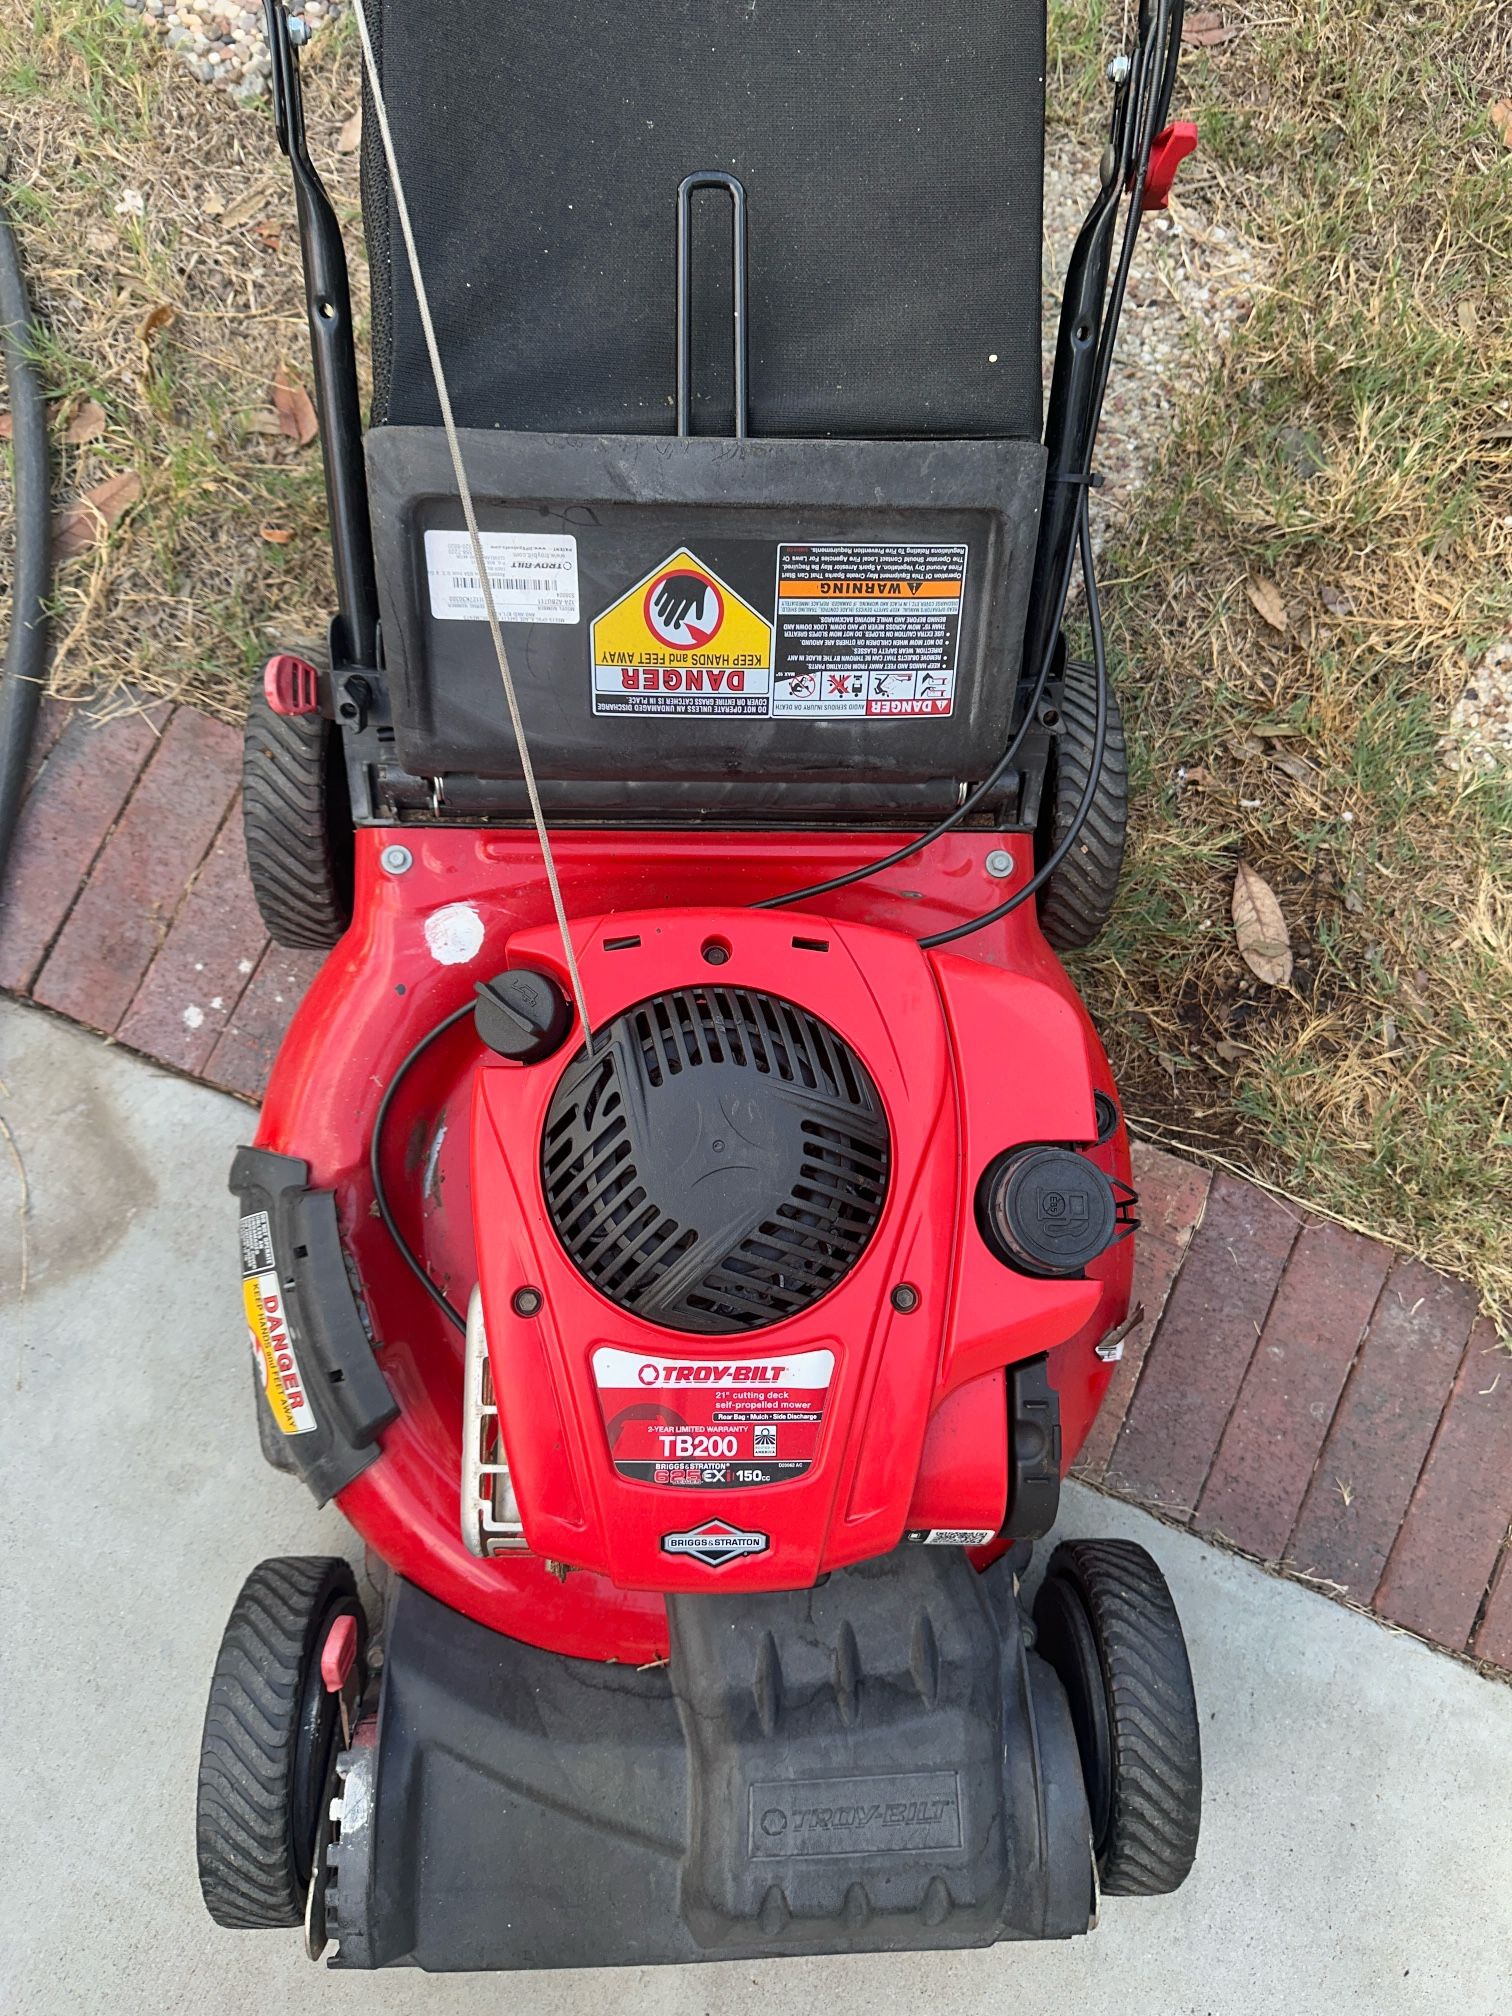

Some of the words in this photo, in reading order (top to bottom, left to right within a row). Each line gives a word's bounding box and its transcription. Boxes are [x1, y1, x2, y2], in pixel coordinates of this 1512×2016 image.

[820, 583, 901, 593] WARNING
[602, 652, 634, 663] AWAY
[638, 652, 665, 664] FEET
[669, 653, 688, 664] and
[692, 654, 729, 665] HANDS
[733, 654, 761, 666] KEEP
[621, 669, 744, 691] DANGER
[872, 701, 932, 712] DANGER
[252, 1283, 264, 1308] KEEP
[258, 1312, 271, 1348] HANDS
[267, 1351, 276, 1369] and
[272, 1370, 284, 1395] FEET
[281, 1398, 296, 1427] AWAY
[264, 1295, 304, 1408] DANGER
[662, 1366, 786, 1383] TROY-BILT
[732, 1392, 764, 1400] cutting
[716, 1401, 778, 1410] self-propelled
[659, 1436, 737, 1456] TB200
[670, 1538, 760, 1546] BRIGGS&STRATTON
[792, 1801, 950, 1832] TROY-BILT
